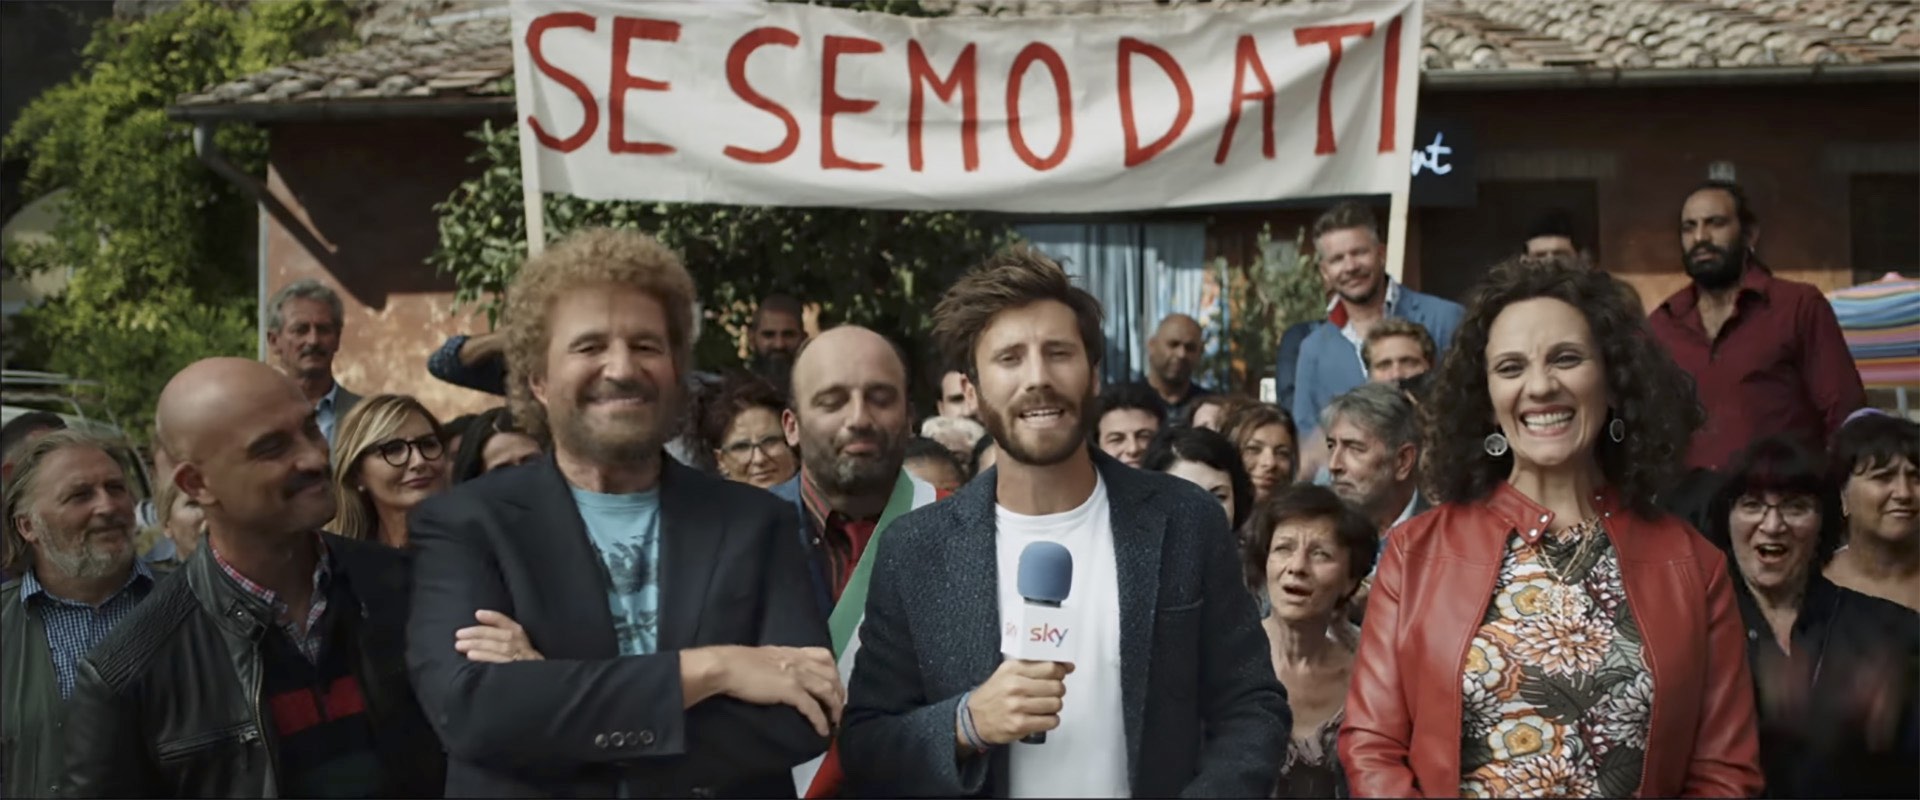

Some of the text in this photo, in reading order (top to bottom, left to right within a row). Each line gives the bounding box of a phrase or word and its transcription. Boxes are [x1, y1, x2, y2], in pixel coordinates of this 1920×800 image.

[526, 12, 1402, 172] SE SEMO DATI
[1030, 622, 1069, 648] sky
